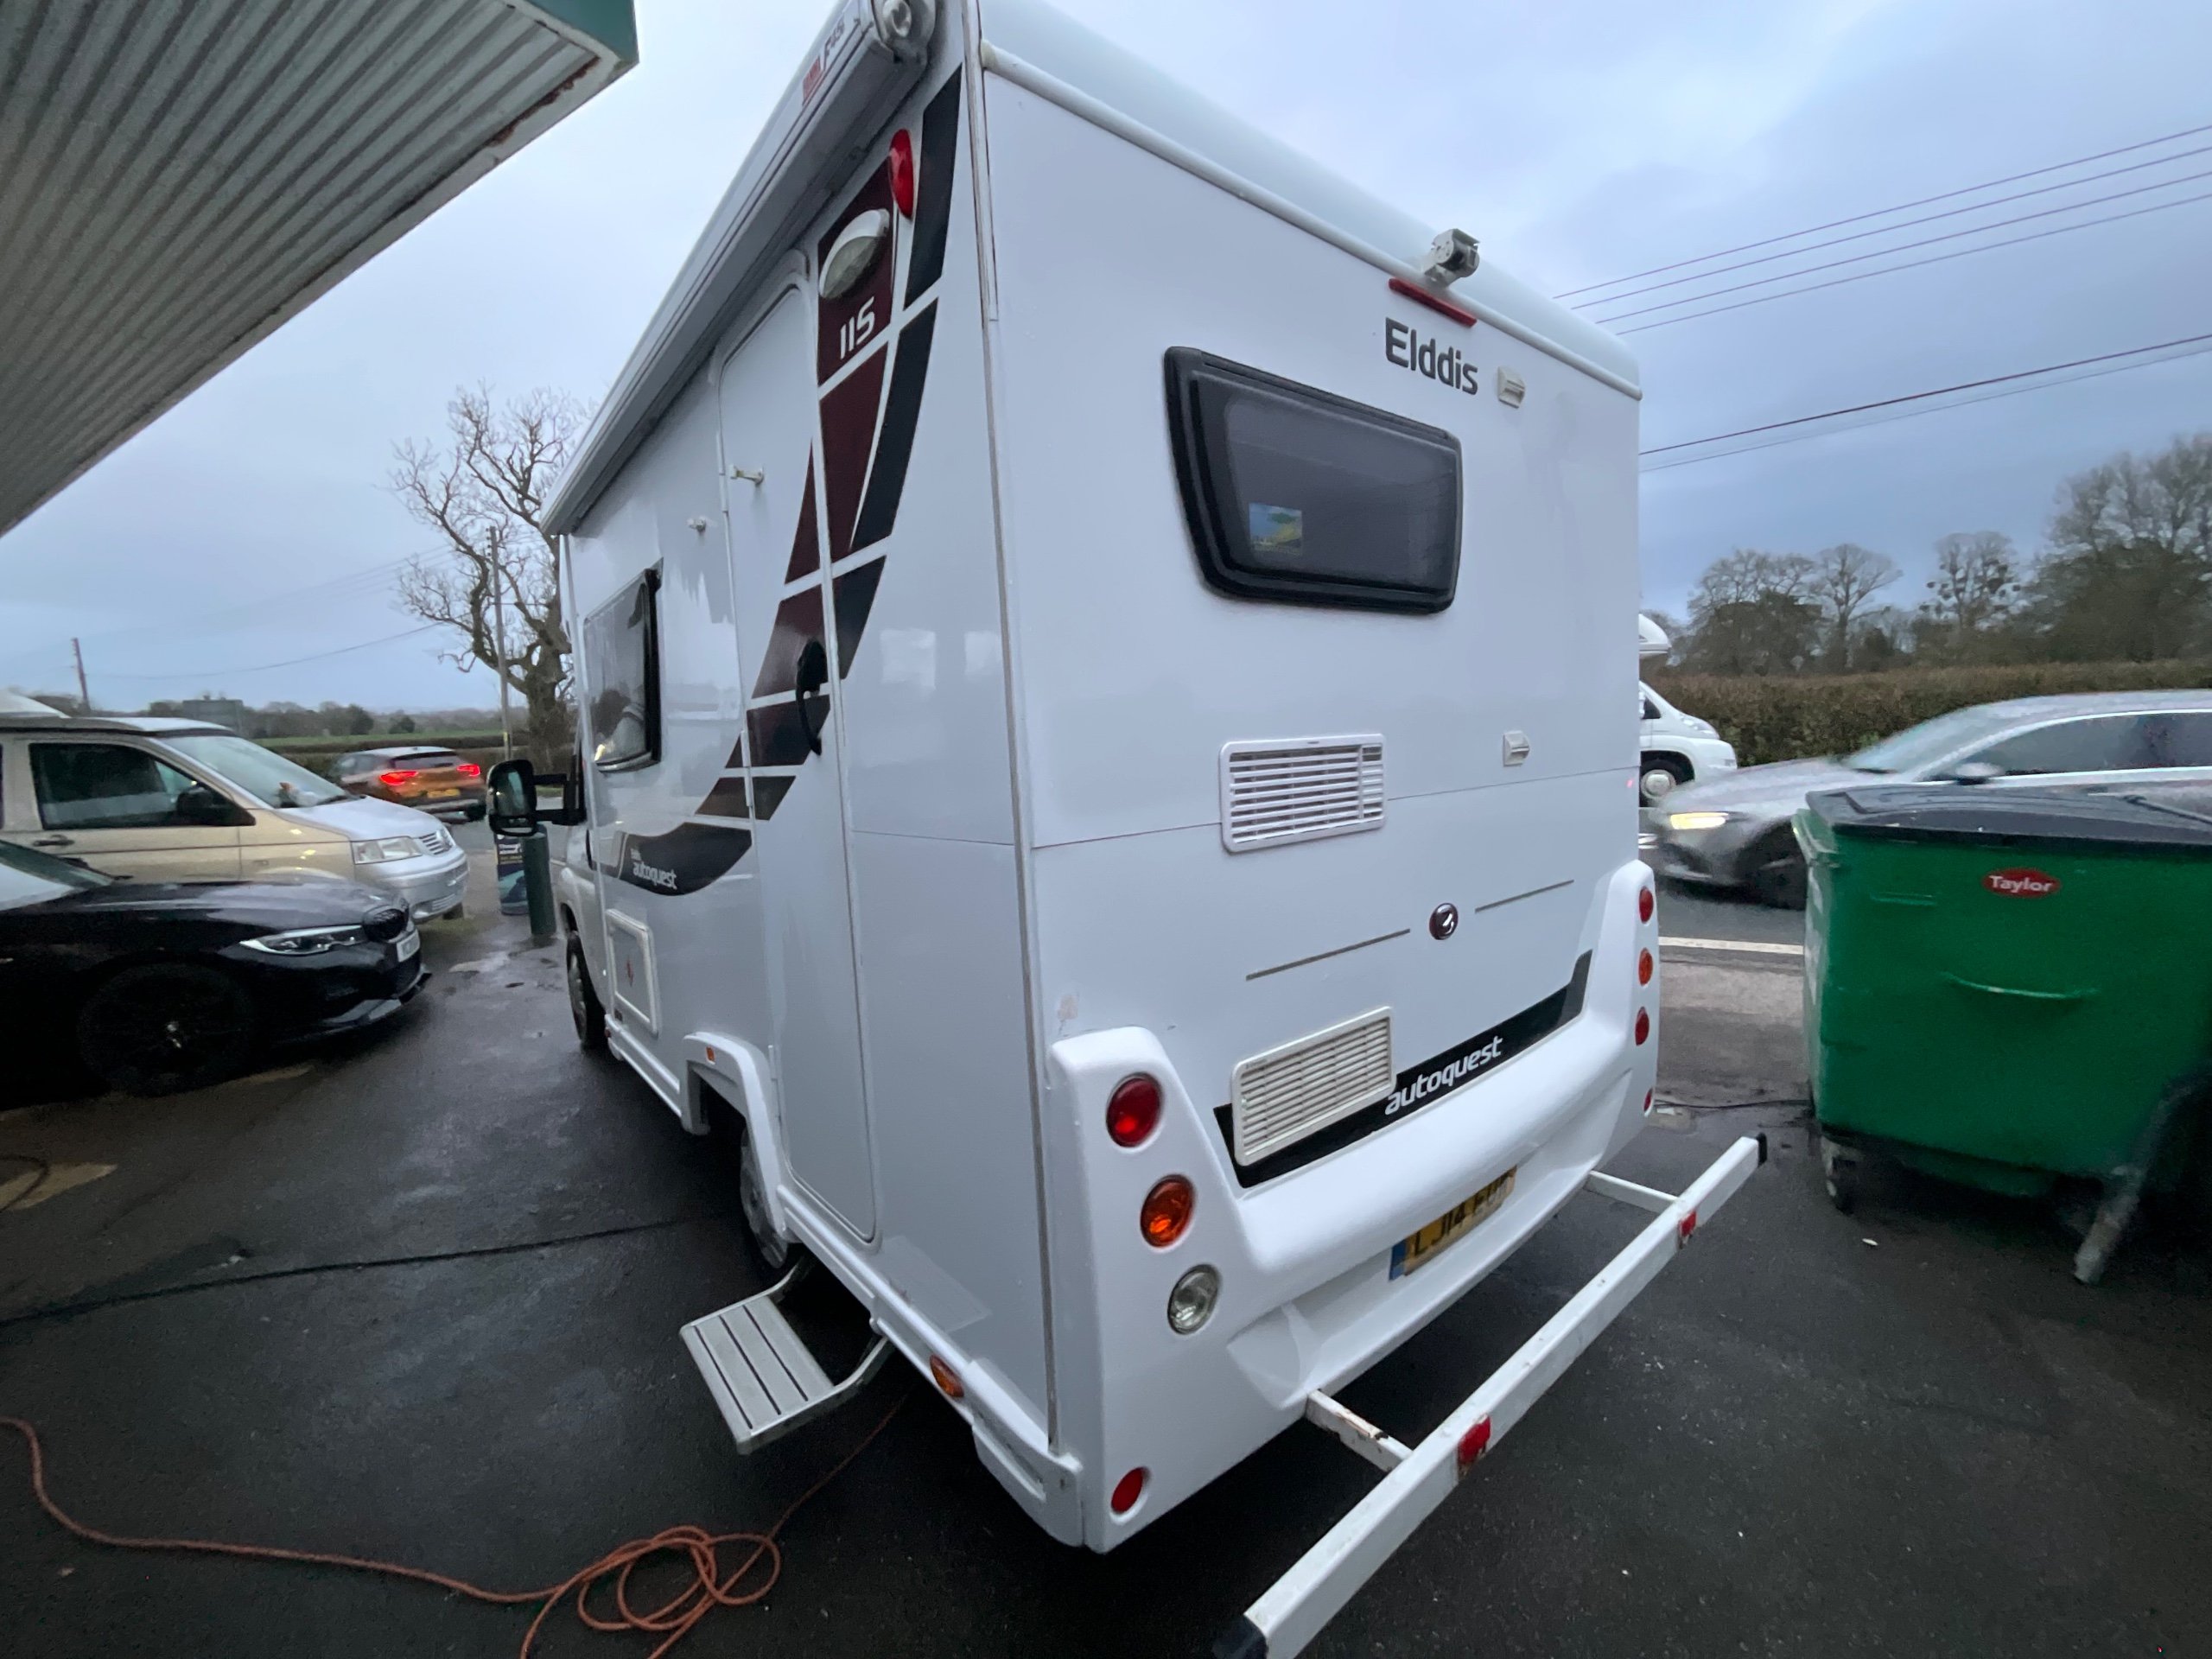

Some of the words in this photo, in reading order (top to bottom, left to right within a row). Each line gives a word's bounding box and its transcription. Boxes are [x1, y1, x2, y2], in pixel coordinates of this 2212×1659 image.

[840, 296, 875, 360] 115
[1385, 317, 1478, 395] Elddis
[1989, 874, 2053, 893] Taylor
[1384, 1035, 1503, 1116] autoquest
